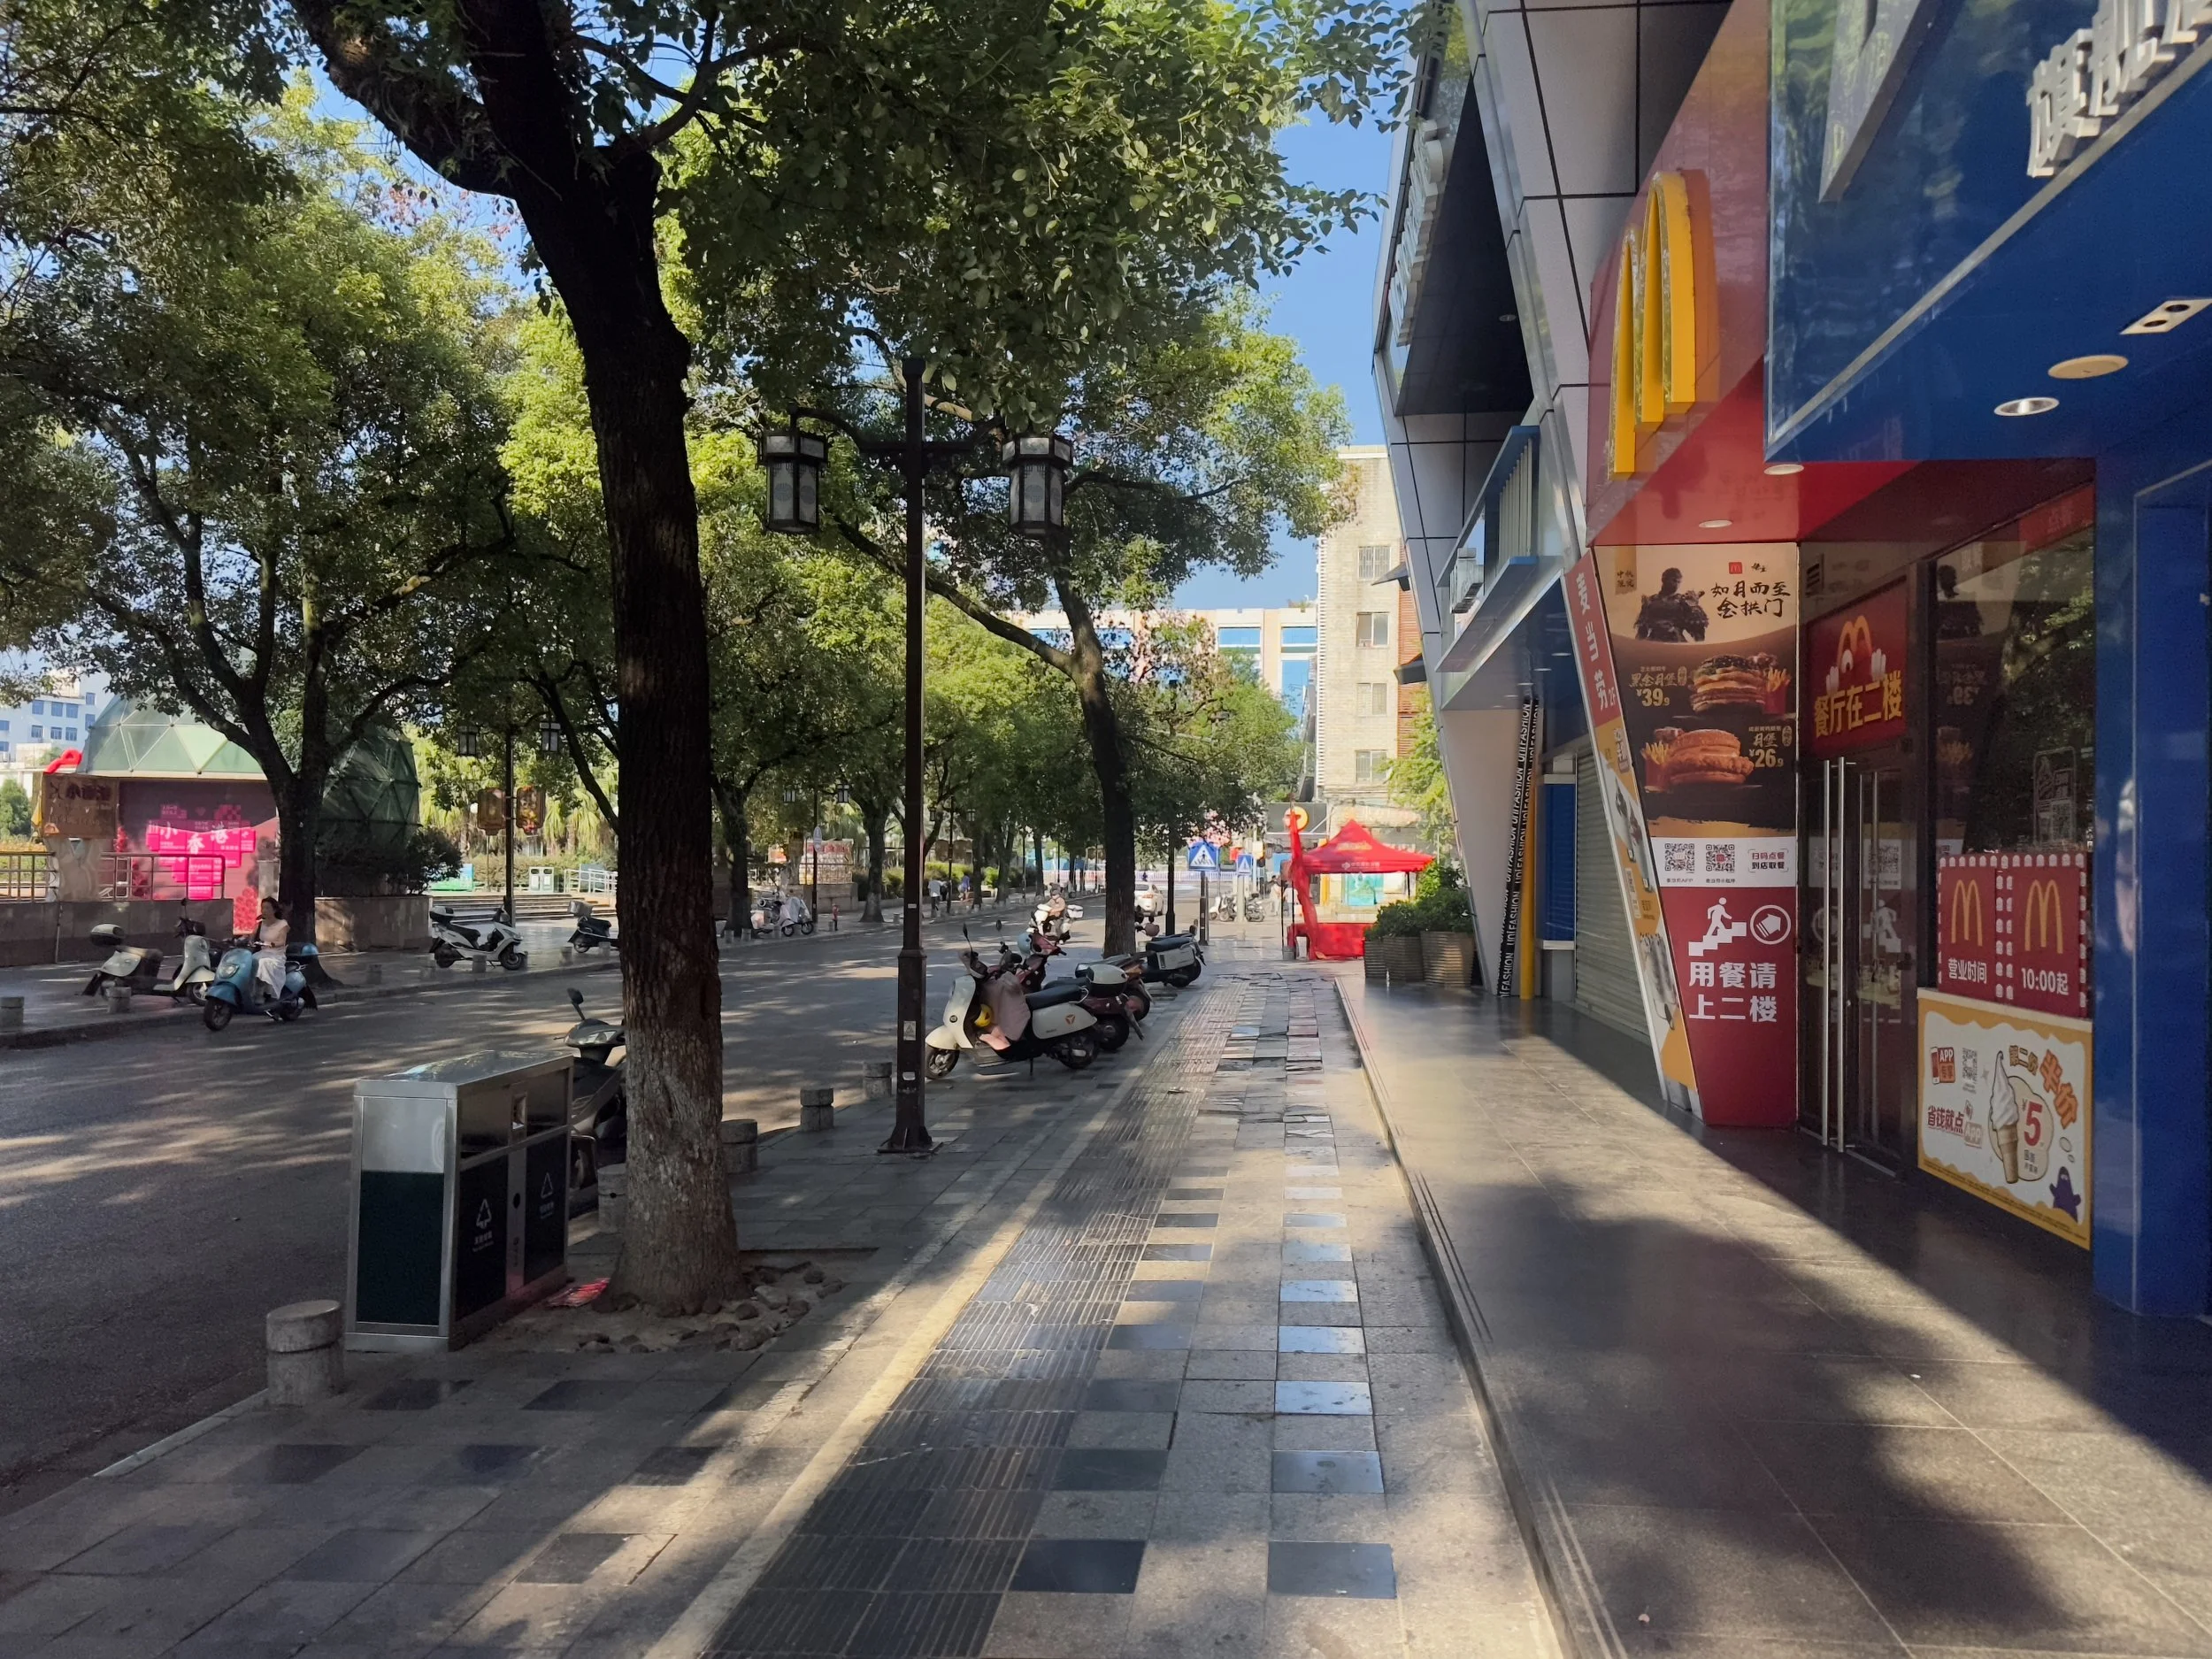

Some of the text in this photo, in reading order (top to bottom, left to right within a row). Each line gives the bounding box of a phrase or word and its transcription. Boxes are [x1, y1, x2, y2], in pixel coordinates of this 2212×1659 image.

[1710, 580, 1791, 598] 如月而至
[1717, 597, 1784, 618] 金拱门
[1576, 572, 1609, 710] 麦当劳
[1814, 670, 1902, 738] 餐厅在二楼
[1751, 861, 1785, 870] 到店取餐
[1501, 952, 1514, 991] FASHION
[1688, 962, 1777, 989] 用餐请
[1947, 957, 1987, 985] 营业时间
[2021, 967, 2070, 995] 10:00起
[1688, 994, 1778, 1023] 上二楼
[1939, 1048, 1954, 1063] APP
[2039, 1048, 2078, 1130] 半价
[1927, 1105, 1964, 1134] 省钱就点
